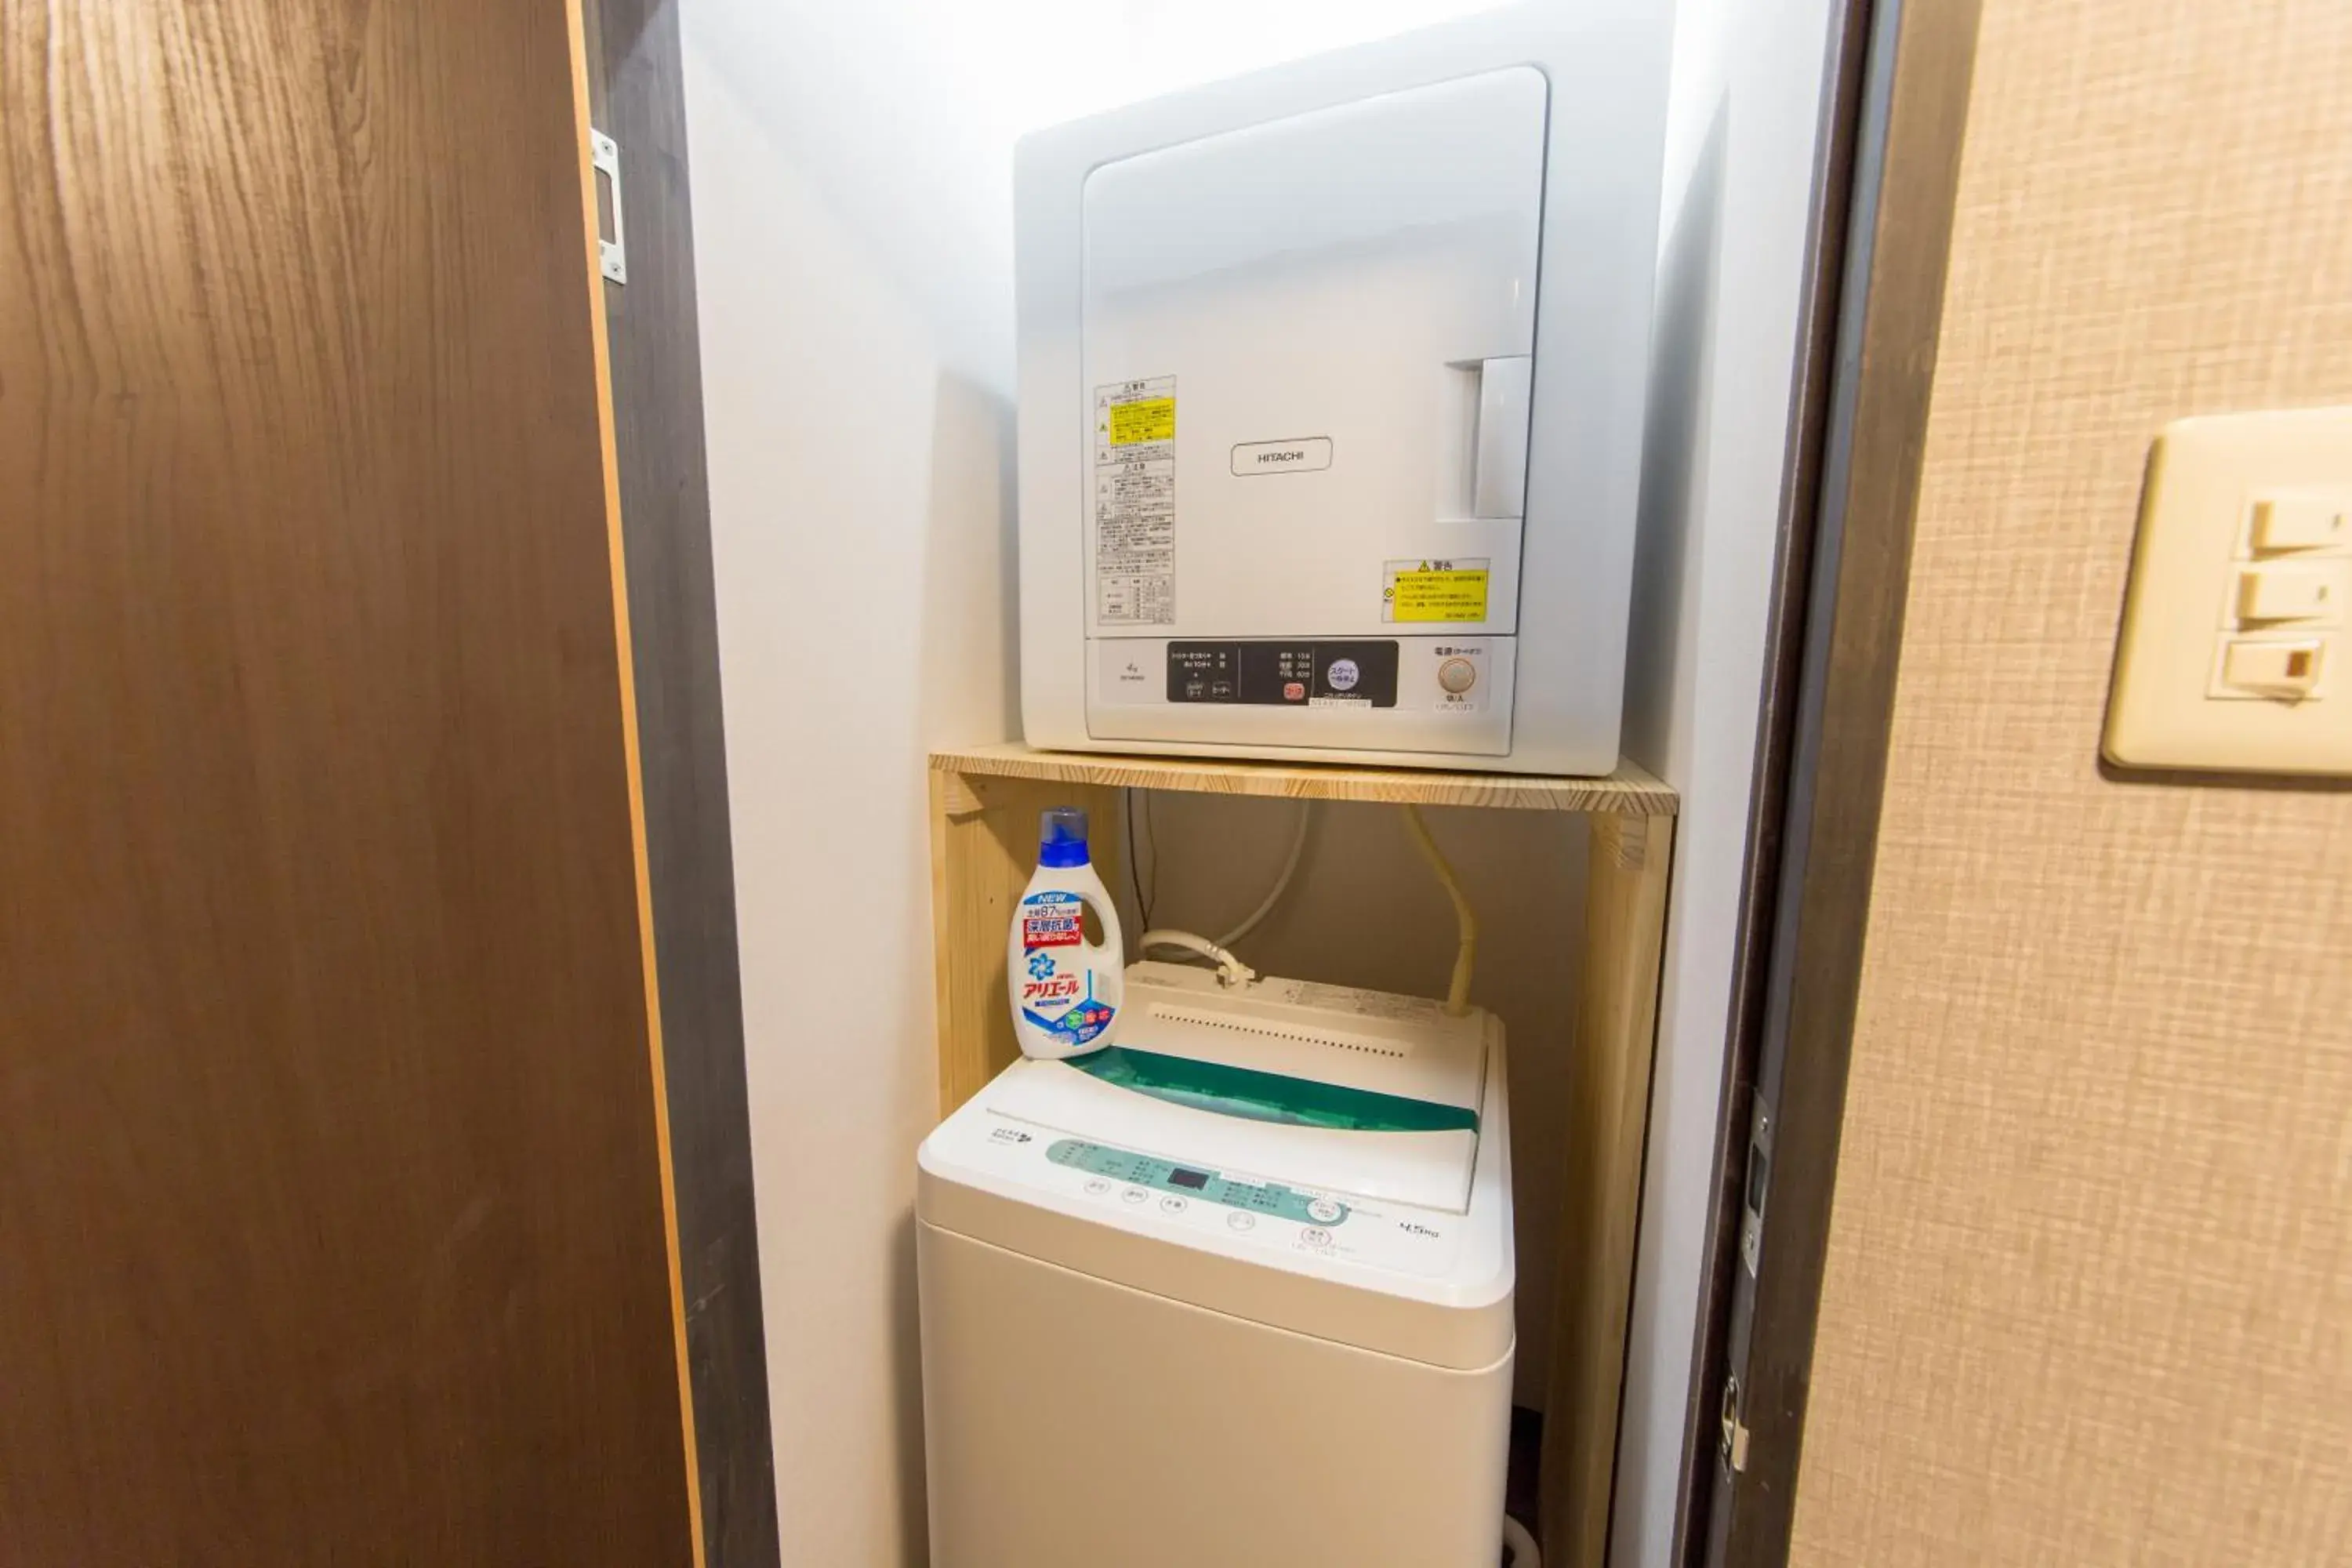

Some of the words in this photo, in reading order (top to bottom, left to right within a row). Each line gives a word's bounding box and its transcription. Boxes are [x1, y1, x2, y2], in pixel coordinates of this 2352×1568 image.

[1258, 452, 1304, 463] HITACHI
[1038, 894, 1067, 903] NEW
[1023, 981, 1080, 998] アリエール
